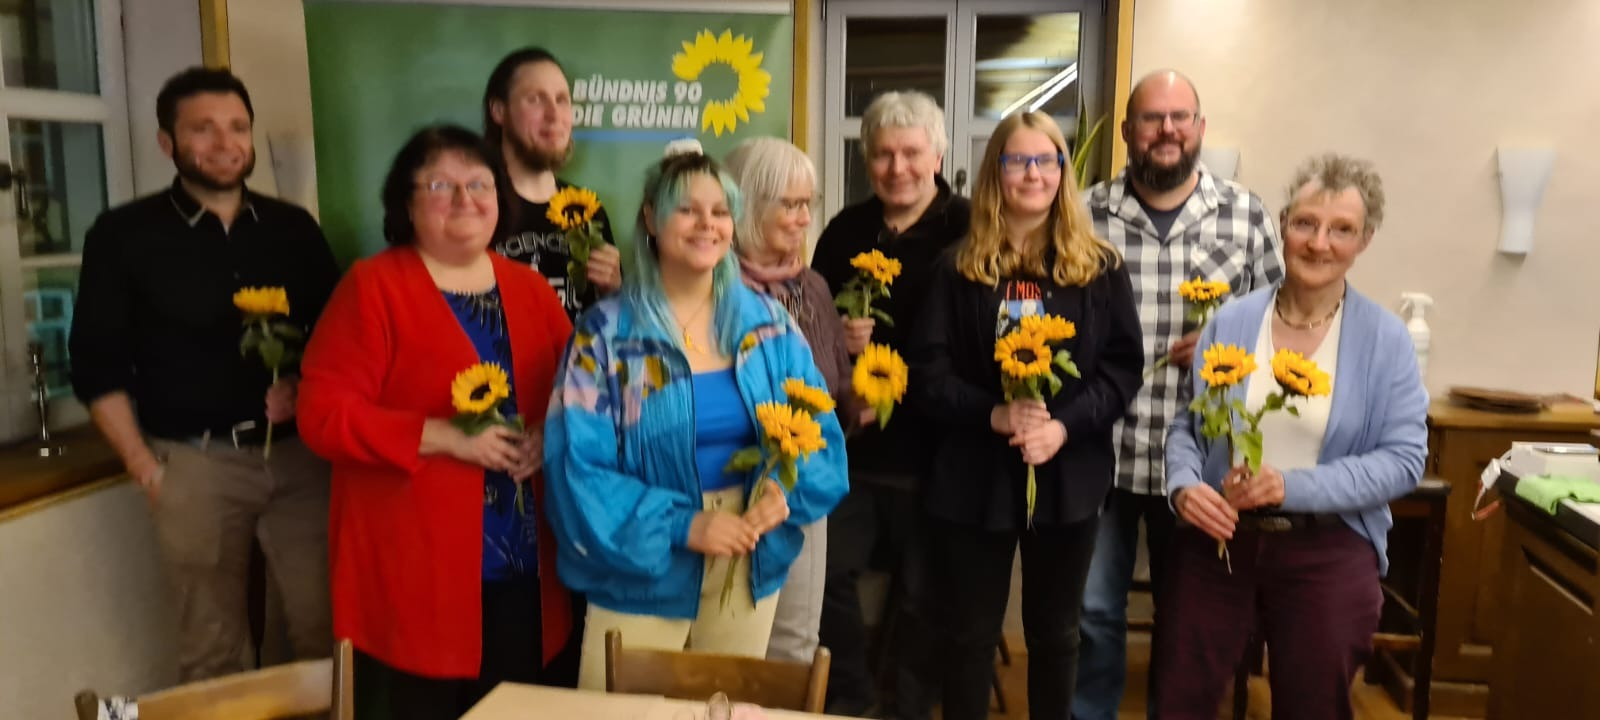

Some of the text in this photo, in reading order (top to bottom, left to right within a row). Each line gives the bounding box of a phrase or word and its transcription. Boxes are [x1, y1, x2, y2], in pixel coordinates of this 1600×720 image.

[573, 74, 702, 103] BÜNDNIS 90
[572, 101, 699, 128] DIE GRÜNEN
